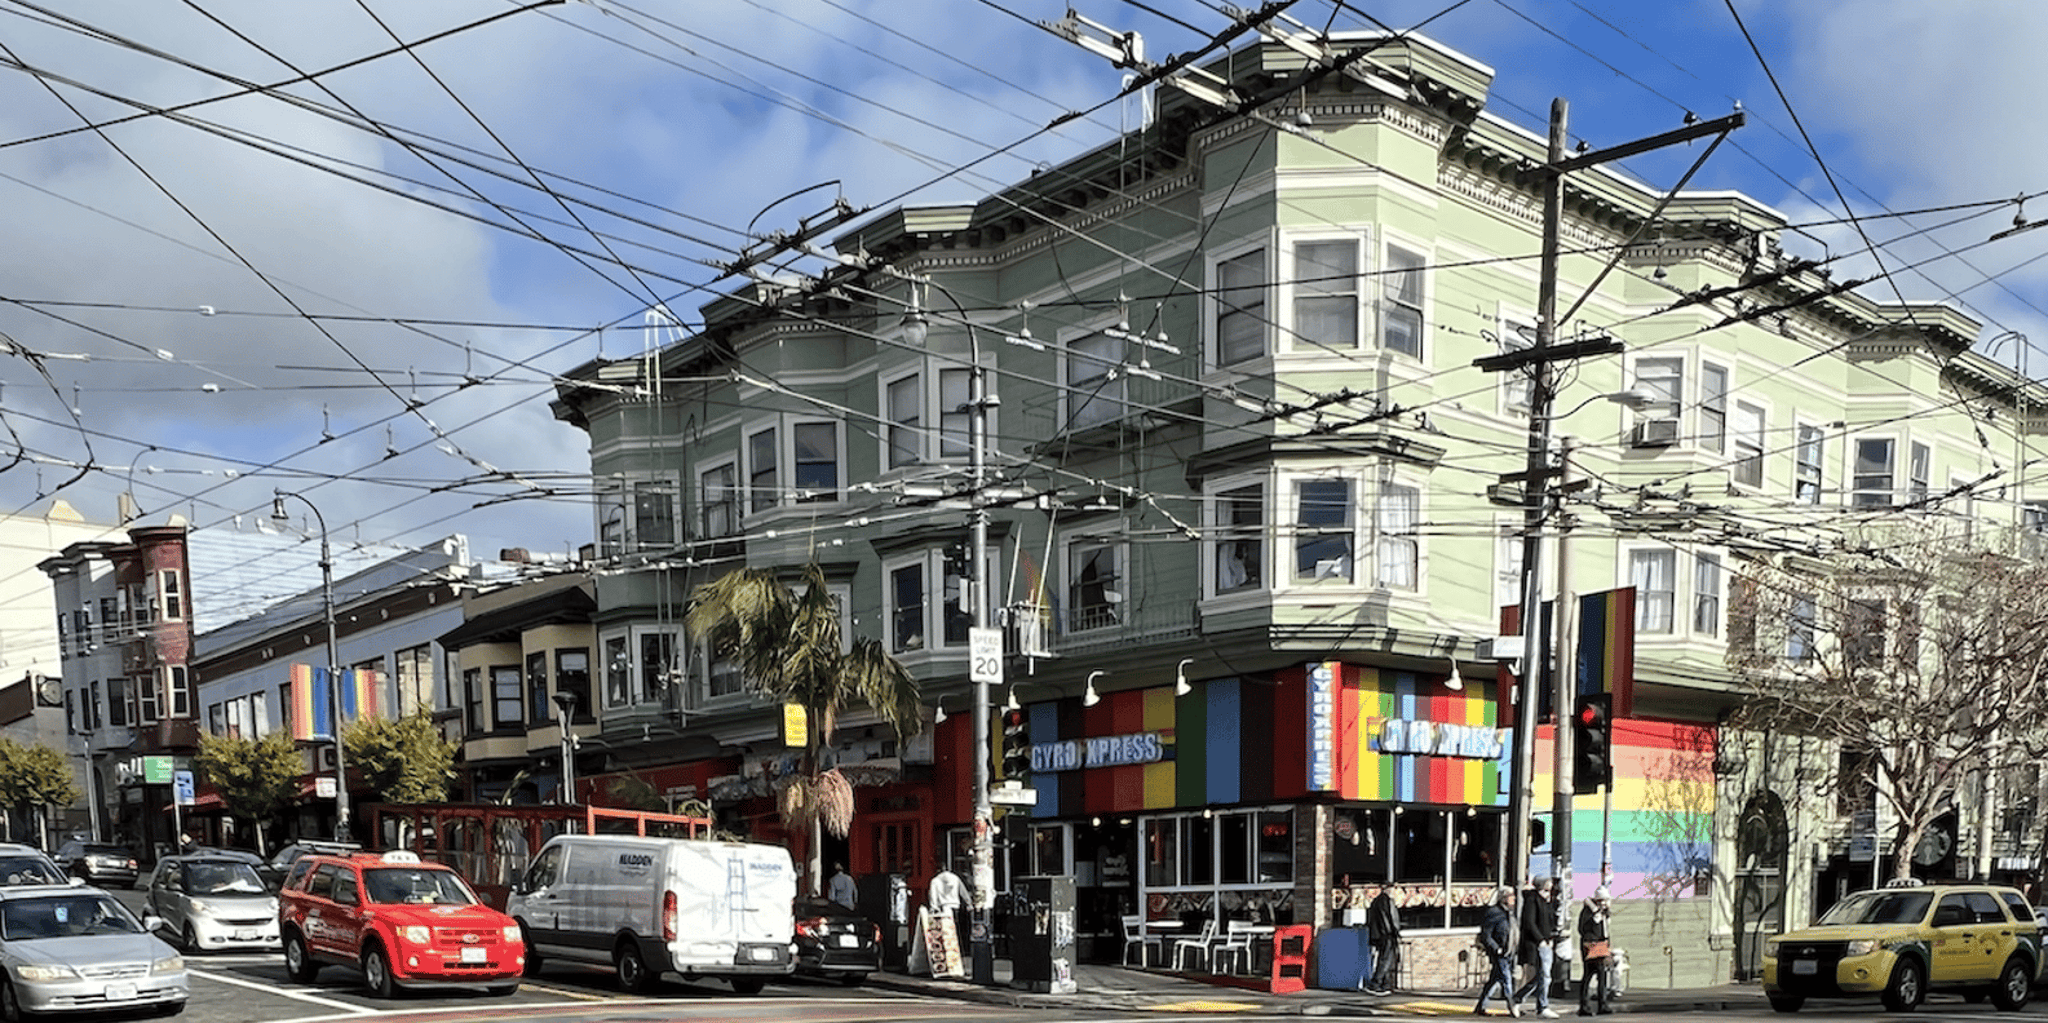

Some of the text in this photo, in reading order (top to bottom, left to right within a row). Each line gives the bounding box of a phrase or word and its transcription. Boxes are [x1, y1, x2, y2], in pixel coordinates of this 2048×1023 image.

[973, 635, 999, 646] SPEED
[975, 646, 997, 654] LIMIT
[975, 656, 999, 676] 20
[1031, 733, 1159, 770] GYRO XPRESS
[619, 854, 654, 866] MADDEN
[1889, 879, 1916, 888] TAXI
